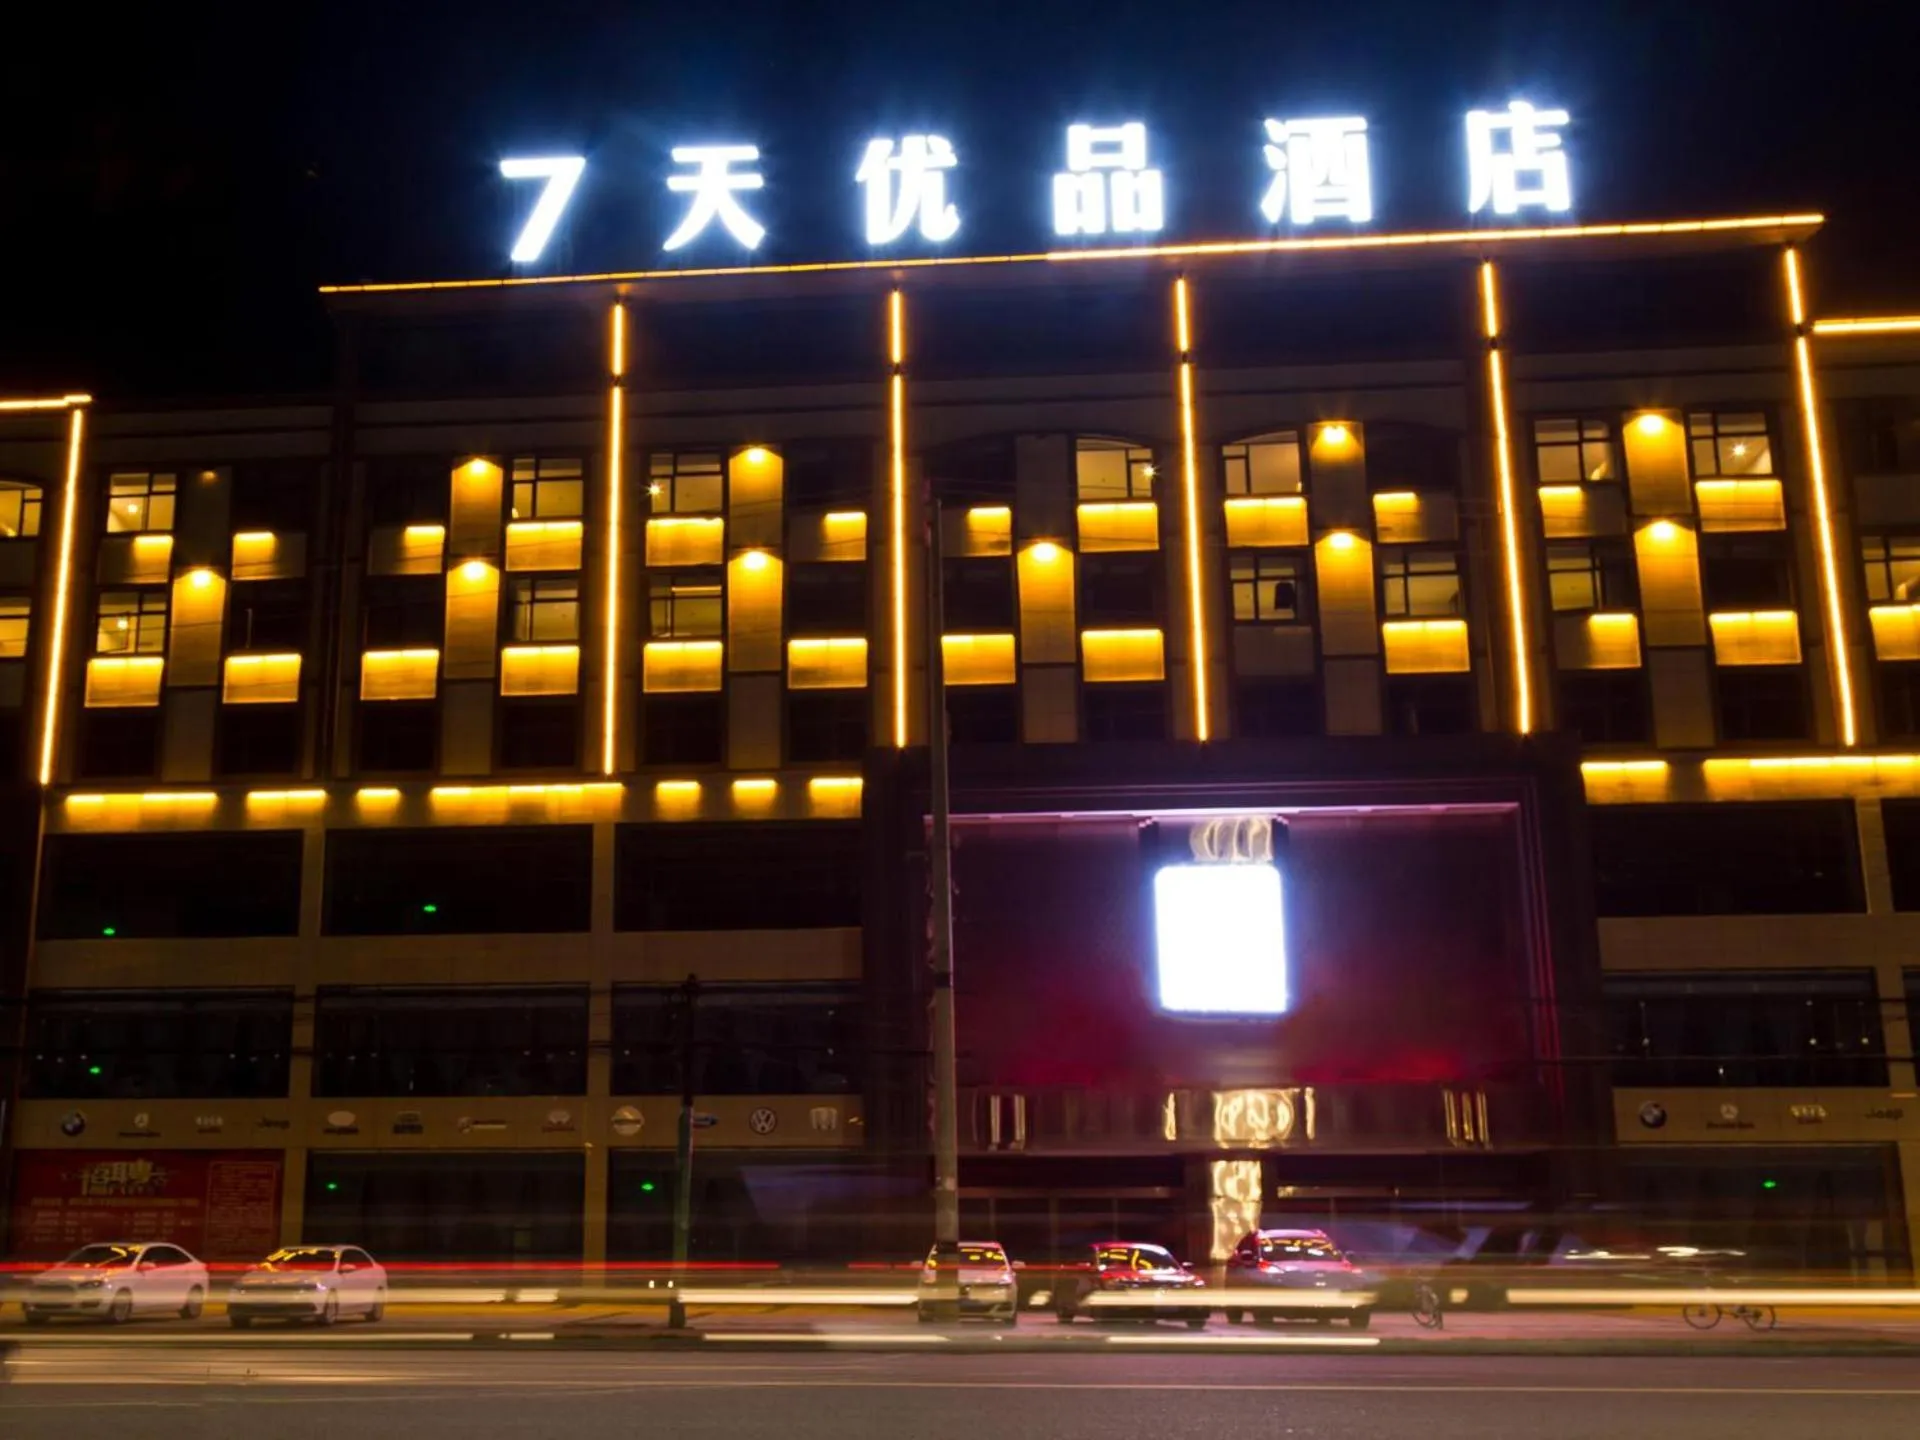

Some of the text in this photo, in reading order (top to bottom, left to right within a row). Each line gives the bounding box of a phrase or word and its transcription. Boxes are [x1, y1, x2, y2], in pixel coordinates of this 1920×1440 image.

[499, 100, 1571, 263] 7天优品酒店
